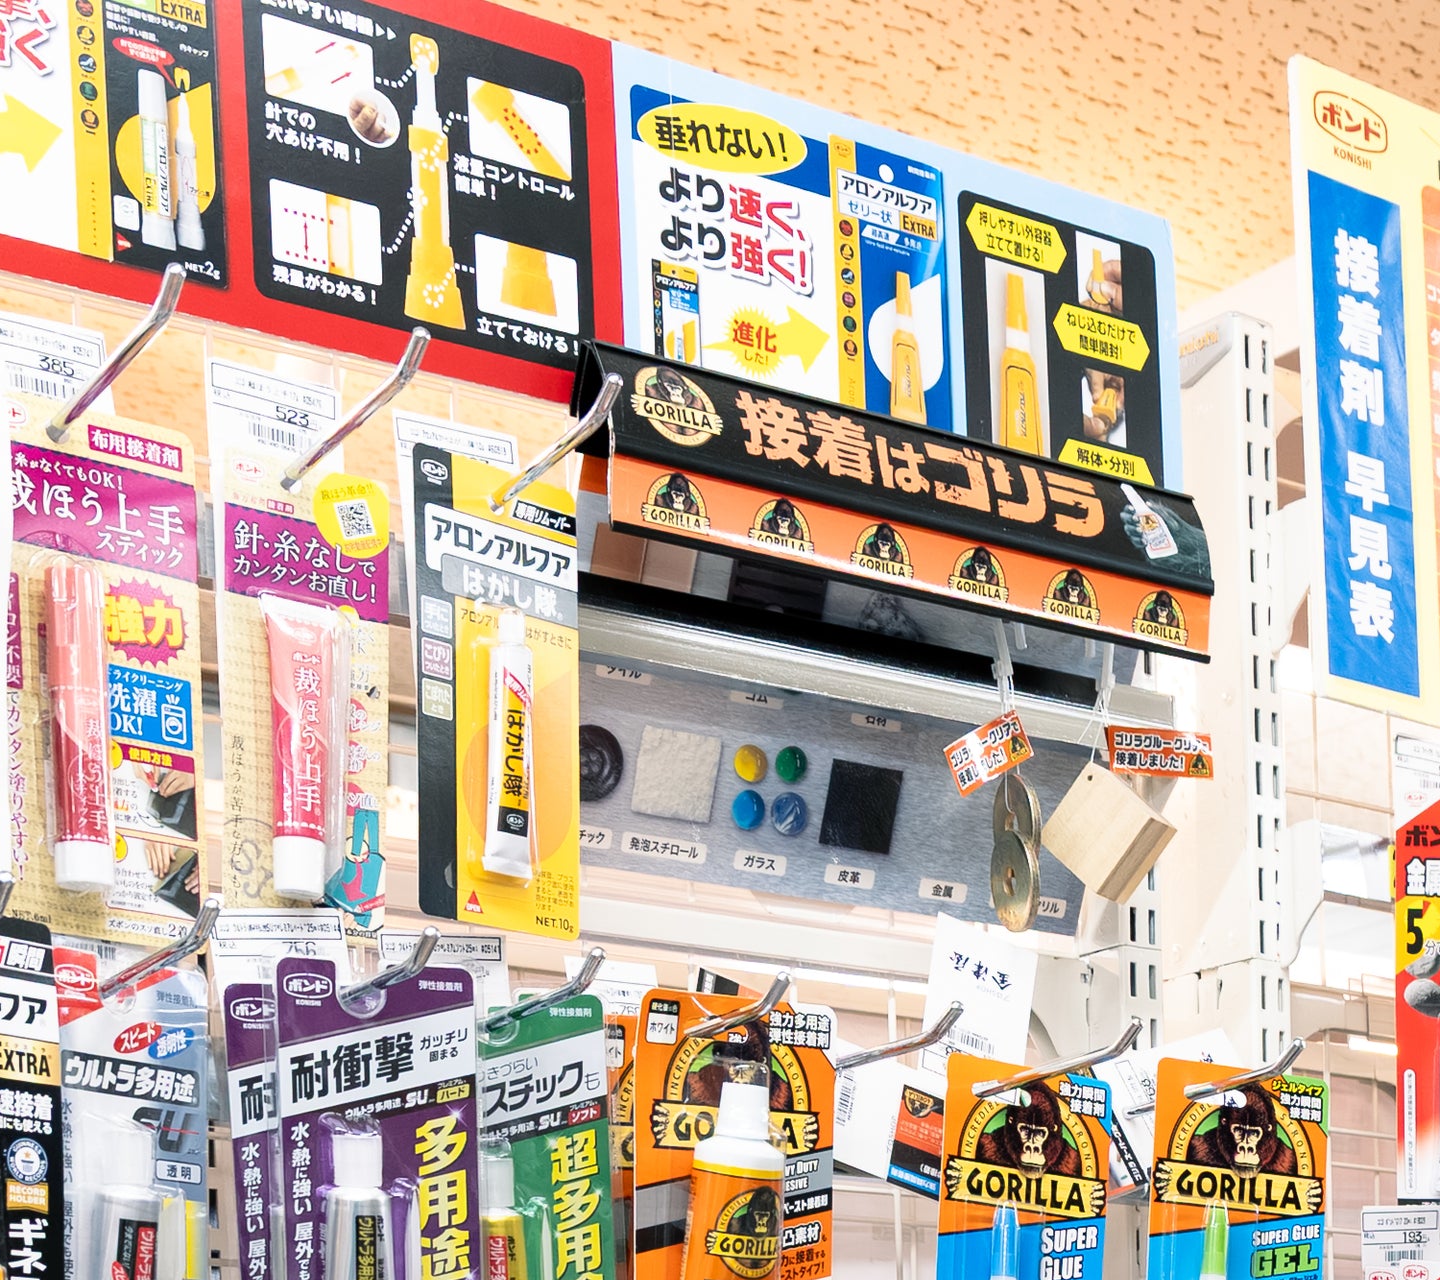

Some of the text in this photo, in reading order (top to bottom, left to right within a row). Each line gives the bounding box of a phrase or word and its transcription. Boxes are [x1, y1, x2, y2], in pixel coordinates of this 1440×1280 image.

[265, 102, 312, 129] 針での
[1320, 101, 1382, 143] ボンド
[655, 114, 788, 162] 垂れない!
[1333, 145, 1373, 170] KONISHI
[978, 214, 1052, 249] 押しやすい外容器
[1066, 312, 1136, 346] ねじ込むだけで
[90, 431, 181, 470] 布用接着剤
[1334, 229, 1395, 645] 接着剤 早見表
[638, 392, 1104, 538] GORILLA 接着はゴリラ
[97, 531, 184, 568] スティック
[460, 564, 557, 616] はがし隊
[629, 835, 700, 860] 発泡スチロール
[742, 855, 776, 871] ガラス
[420, 1029, 468, 1050] ガッチリ
[66, 1056, 196, 1102] ウルトラ多用途
[289, 1032, 415, 1104] 耐衝撃
[967, 1168, 1086, 1212] GORILLA
[1177, 1168, 1299, 1211] GORILLA
[1042, 1227, 1097, 1249] SUPER
[1253, 1226, 1321, 1247] SUPER GLUE
[1040, 1255, 1083, 1280] GLUE
[1253, 1245, 1319, 1278] GEL
